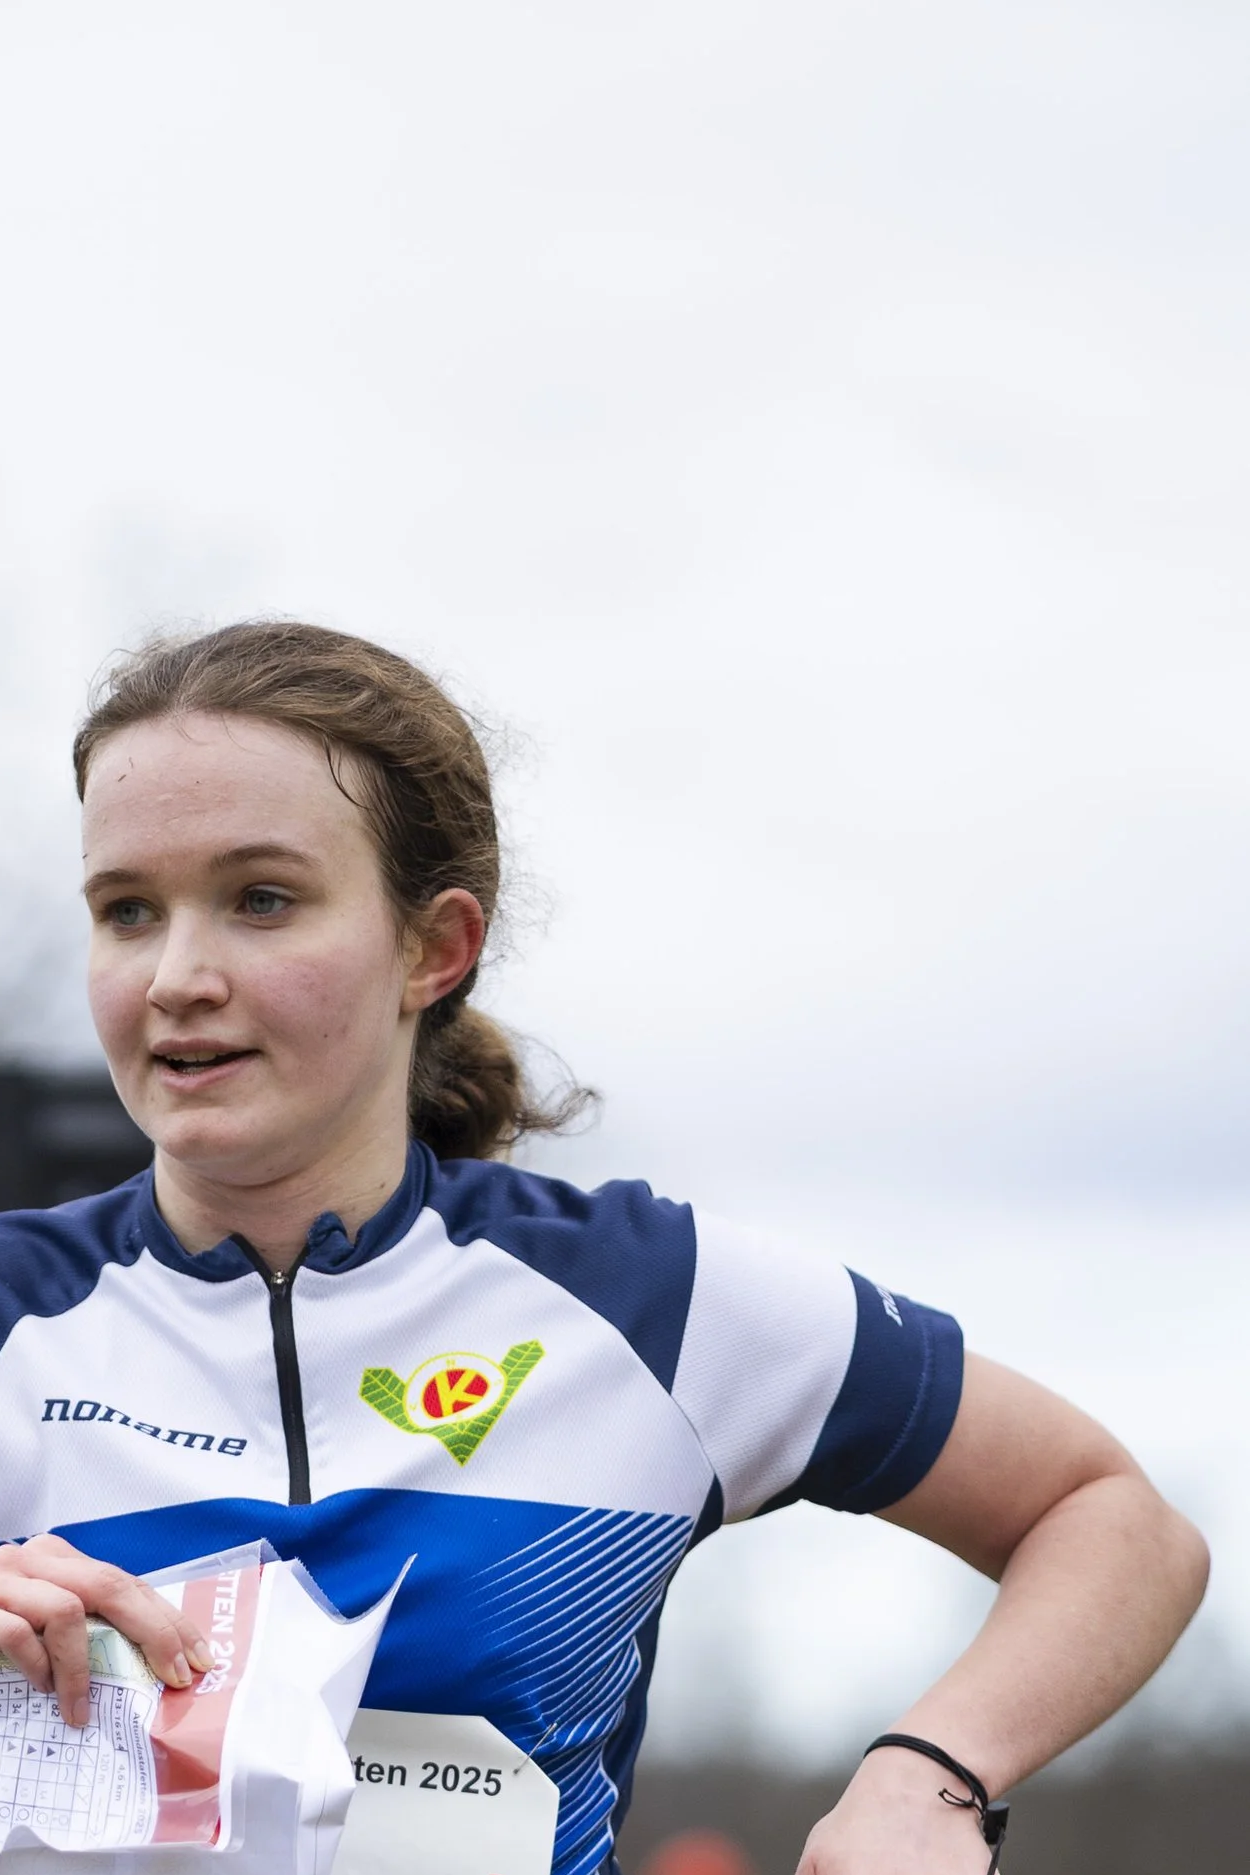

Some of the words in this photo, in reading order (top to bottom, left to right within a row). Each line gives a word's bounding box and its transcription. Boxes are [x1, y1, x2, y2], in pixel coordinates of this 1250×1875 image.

[41, 1399, 247, 1456] noname
[351, 1755, 407, 1786] ten
[419, 1762, 503, 1796] 2025
